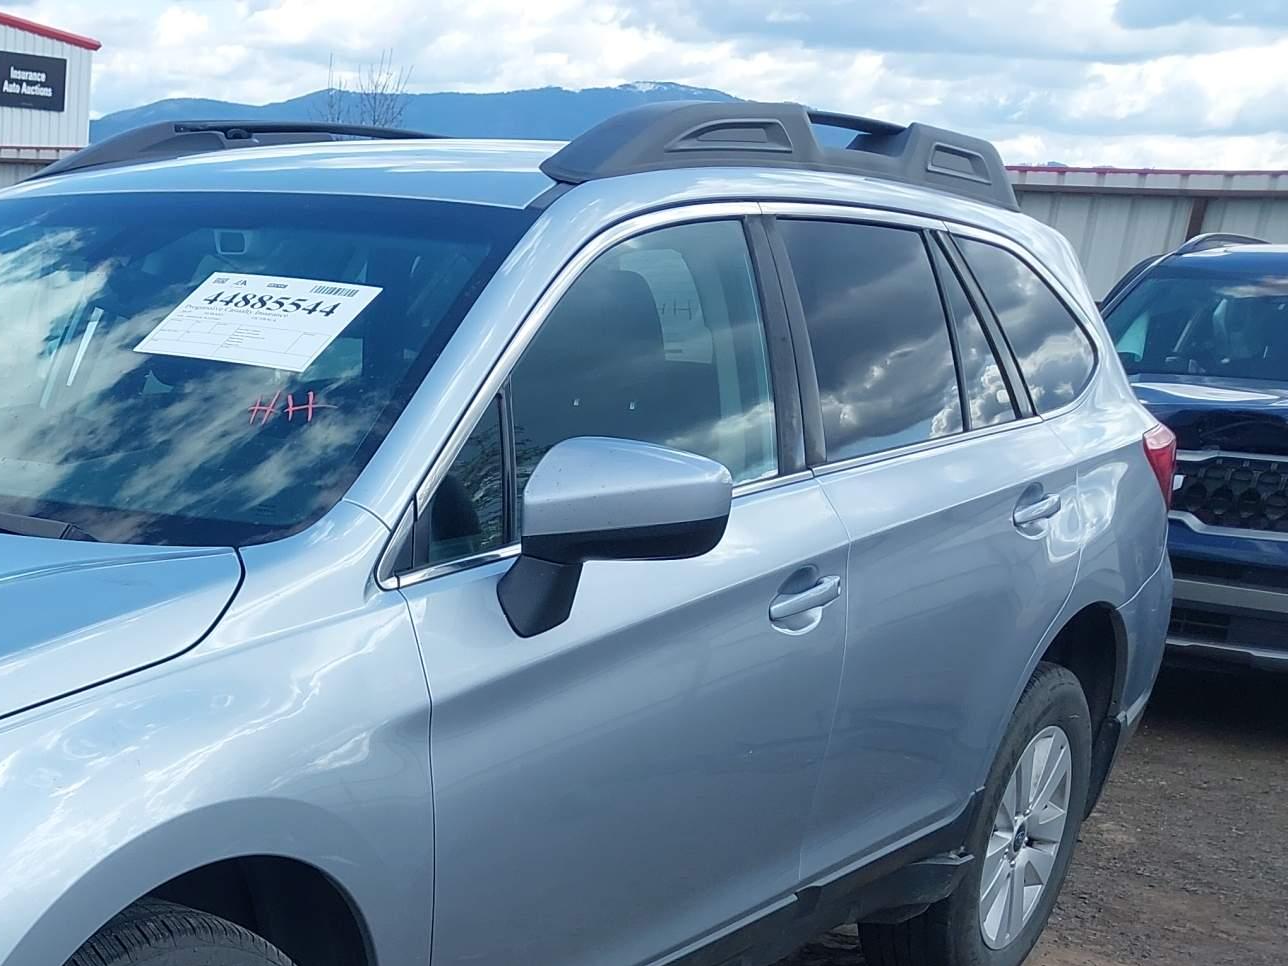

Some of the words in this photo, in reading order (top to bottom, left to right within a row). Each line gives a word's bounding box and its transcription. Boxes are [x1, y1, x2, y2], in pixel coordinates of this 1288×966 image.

[10, 65, 47, 83] Insurance
[2, 79, 21, 95] Auto
[21, 81, 53, 98] Auctions
[203, 290, 341, 317] 44885544
